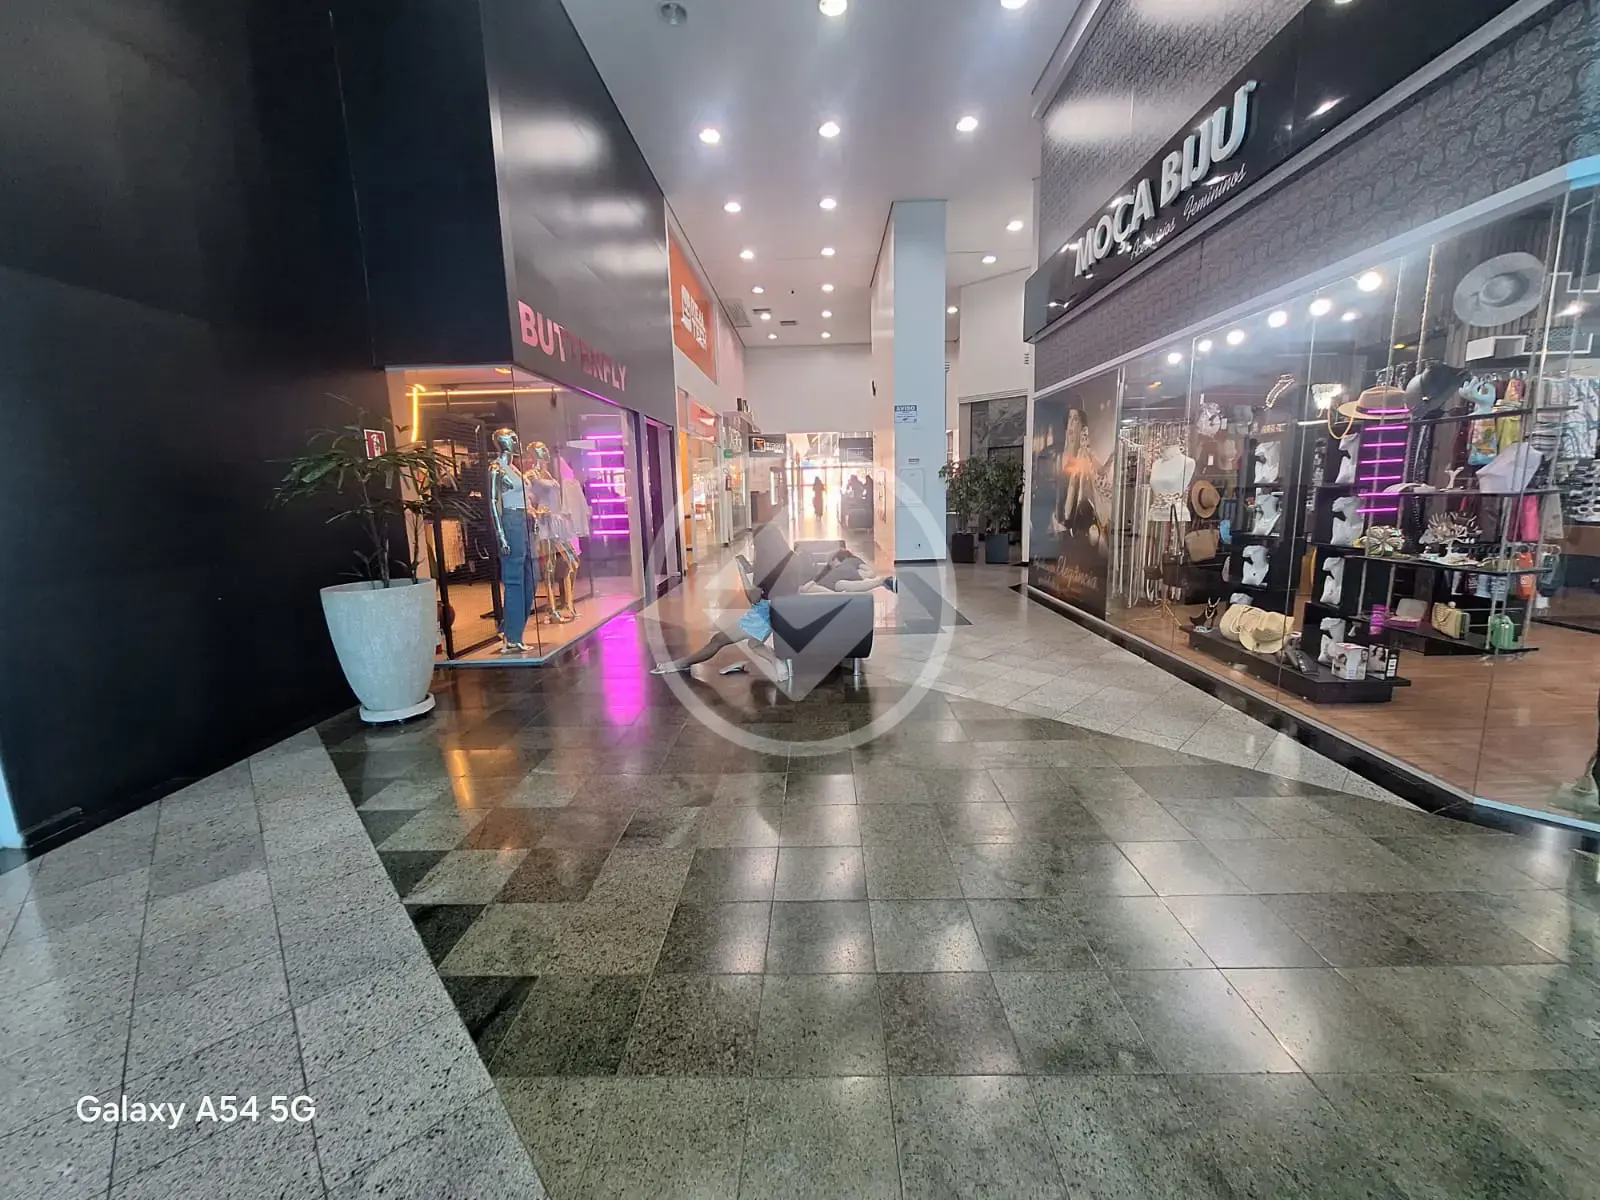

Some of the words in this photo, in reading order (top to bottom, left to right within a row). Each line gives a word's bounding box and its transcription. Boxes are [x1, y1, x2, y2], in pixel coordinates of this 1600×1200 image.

[1075, 178, 1156, 278] MOÇA
[1160, 80, 1257, 208] BIJU
[1183, 163, 1247, 222] Femininos
